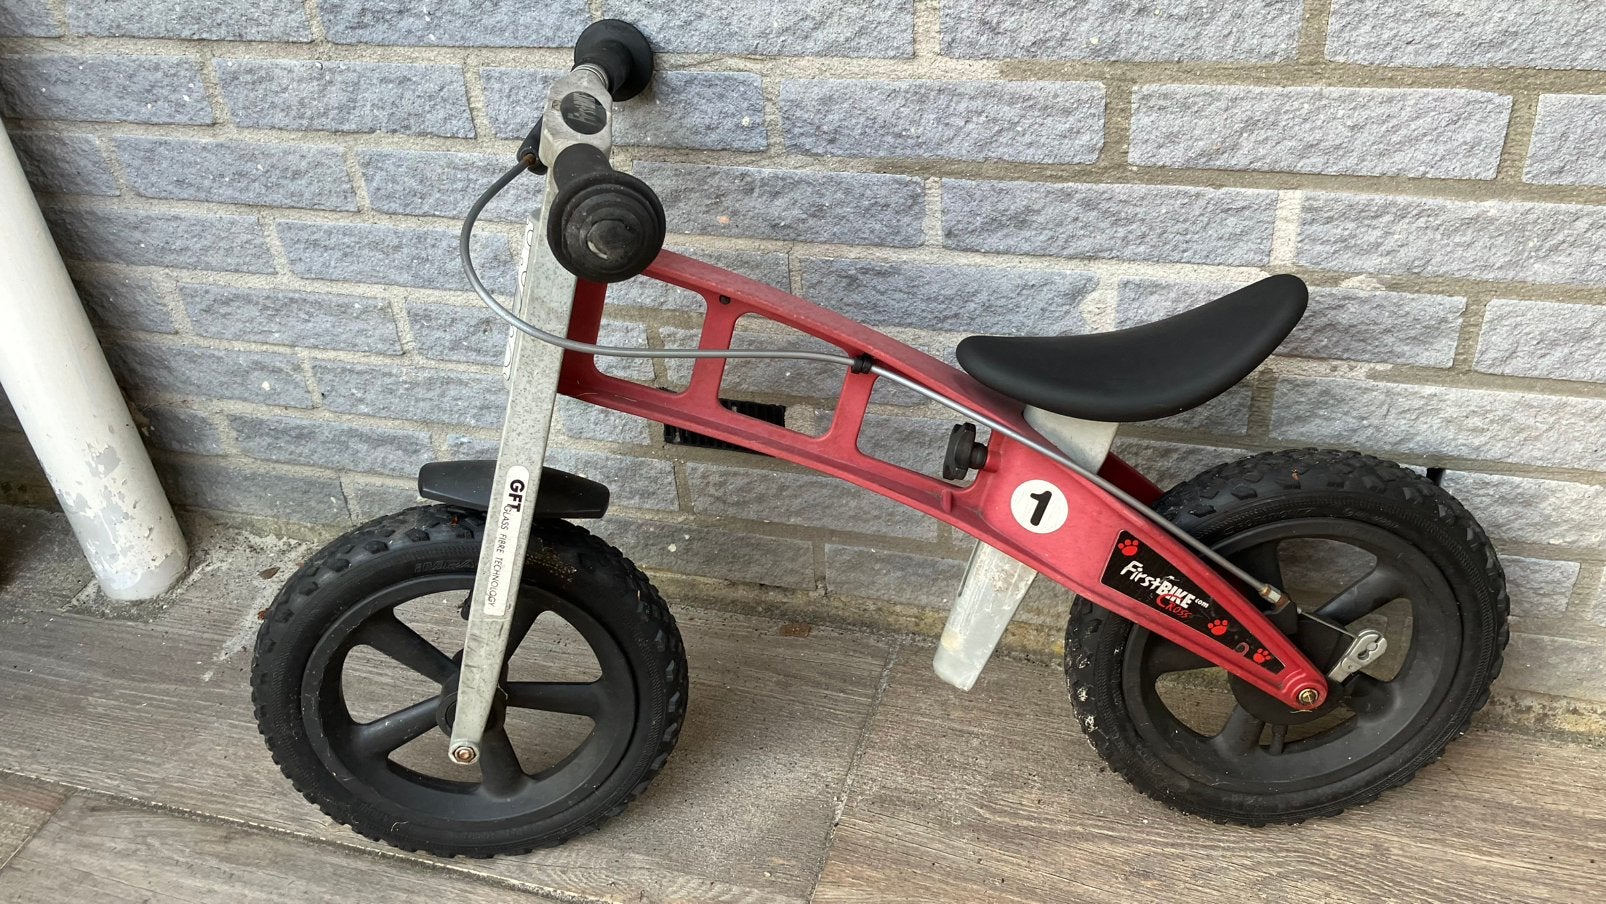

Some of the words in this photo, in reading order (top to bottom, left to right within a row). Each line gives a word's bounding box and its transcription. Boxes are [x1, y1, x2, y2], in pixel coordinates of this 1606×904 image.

[508, 479, 525, 513] GFT
[1030, 490, 1052, 526] 1
[500, 504, 512, 531] GLASS
[496, 533, 507, 553] FIBRE
[487, 556, 503, 608] TECHNOLOGY
